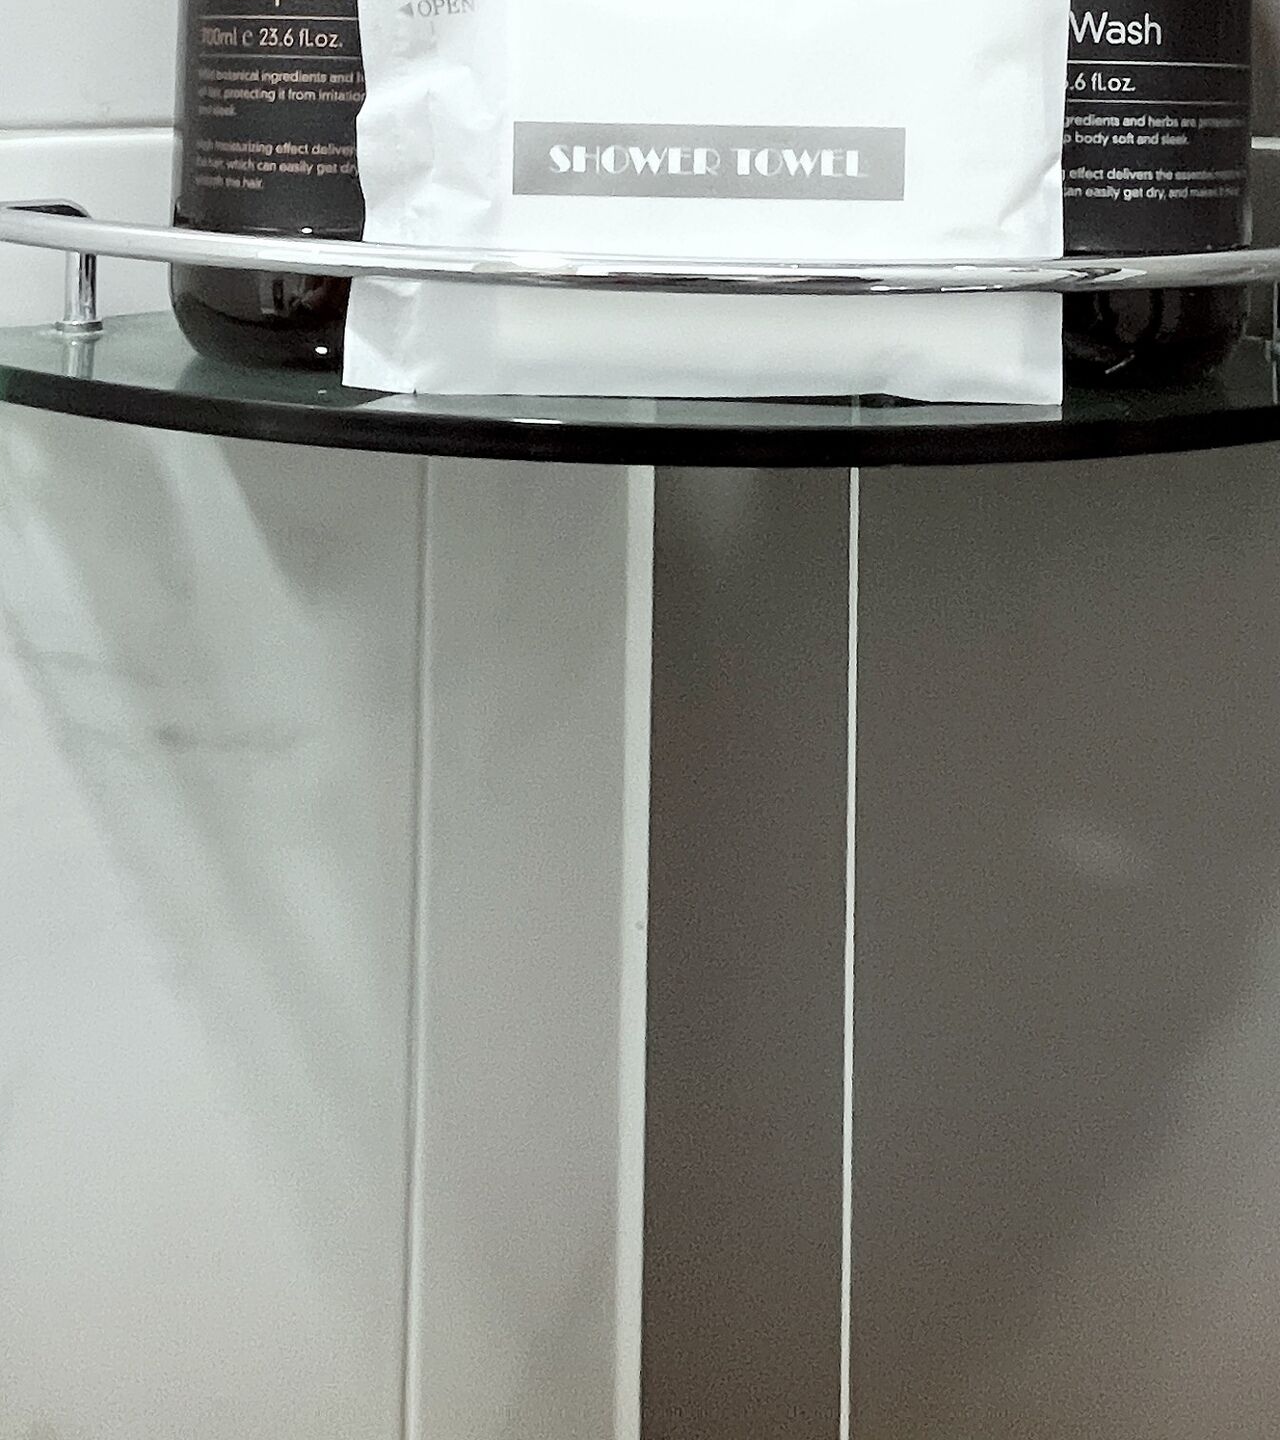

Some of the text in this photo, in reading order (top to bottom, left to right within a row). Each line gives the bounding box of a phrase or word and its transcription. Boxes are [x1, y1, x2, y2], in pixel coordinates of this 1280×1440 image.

[1069, 11, 1163, 46] Wash
[259, 27, 294, 47] 23.6
[261, 70, 326, 85] ingredients
[329, 71, 354, 83] and
[288, 88, 316, 101] from
[1123, 114, 1146, 127] and
[1148, 115, 1178, 128] herbs
[1075, 130, 1109, 147] body
[1112, 132, 1134, 145] soft
[1137, 132, 1159, 145] and
[276, 141, 309, 155] effect
[257, 162, 277, 172] can
[279, 160, 314, 175] easily
[317, 162, 338, 177] get
[548, 144, 868, 178] SHOWER TOWEL
[1069, 166, 1104, 180] effect
[1107, 167, 1153, 180] delivers
[1085, 185, 1120, 201] easily
[1123, 187, 1143, 201] get
